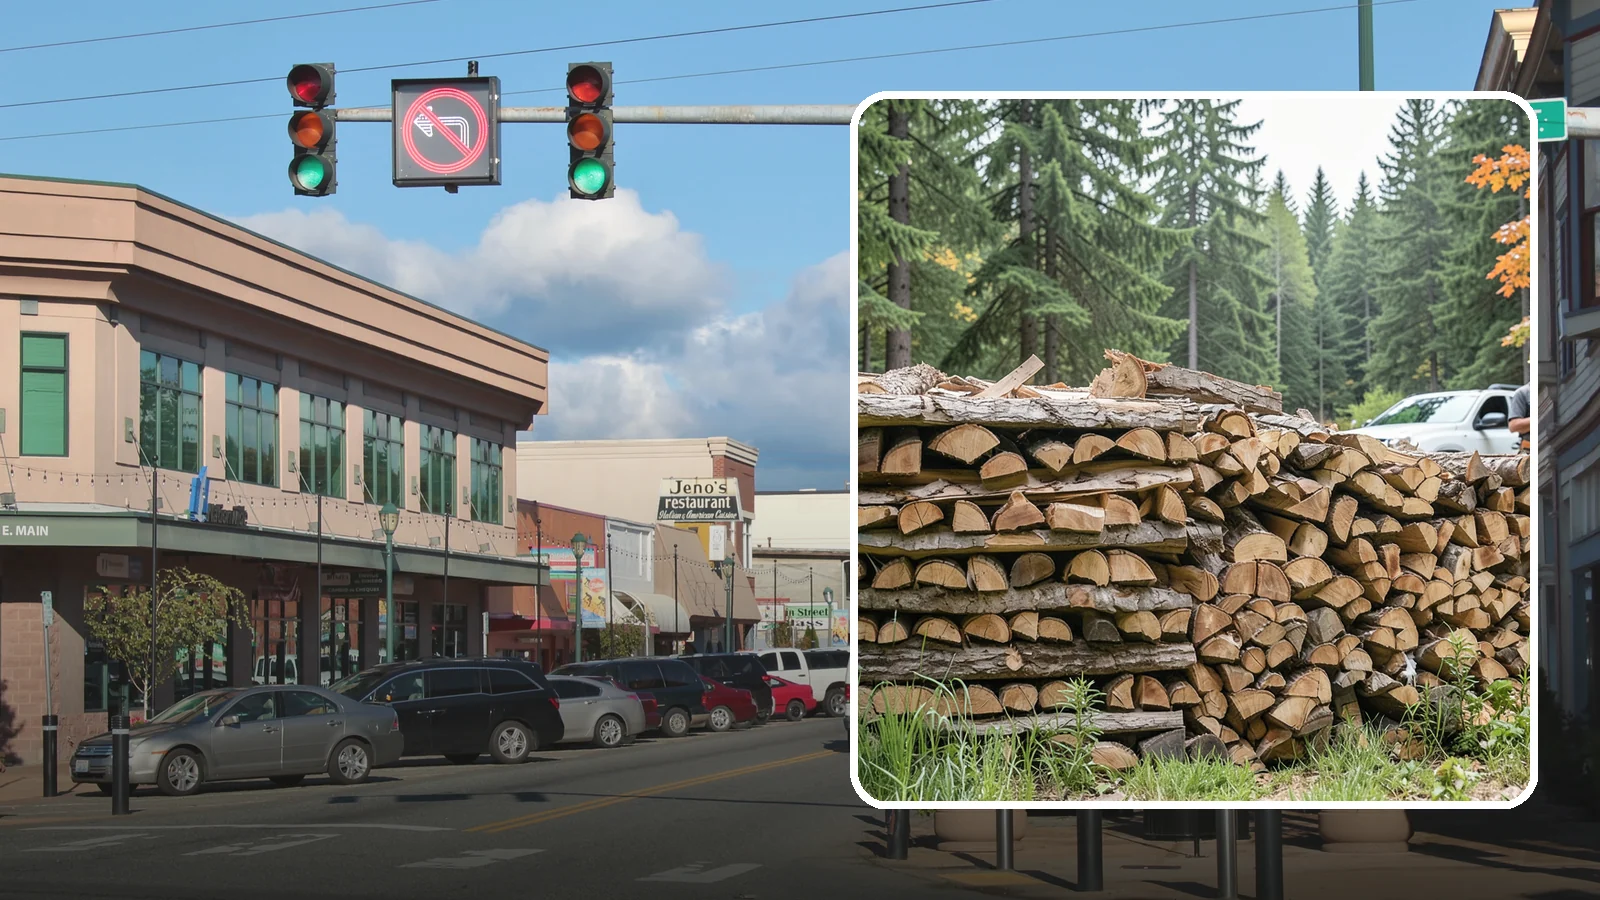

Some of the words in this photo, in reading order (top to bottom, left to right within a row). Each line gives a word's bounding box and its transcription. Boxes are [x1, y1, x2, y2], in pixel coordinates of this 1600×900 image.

[669, 480, 728, 494] Jeno's
[665, 496, 731, 509] restaurant
[658, 510, 681, 520] Italian
[686, 509, 715, 519] American
[715, 509, 737, 519] Cuisine
[2, 525, 13, 536] E.
[15, 525, 49, 536] MAIN
[797, 607, 828, 617] Street
[791, 619, 824, 627] lass
